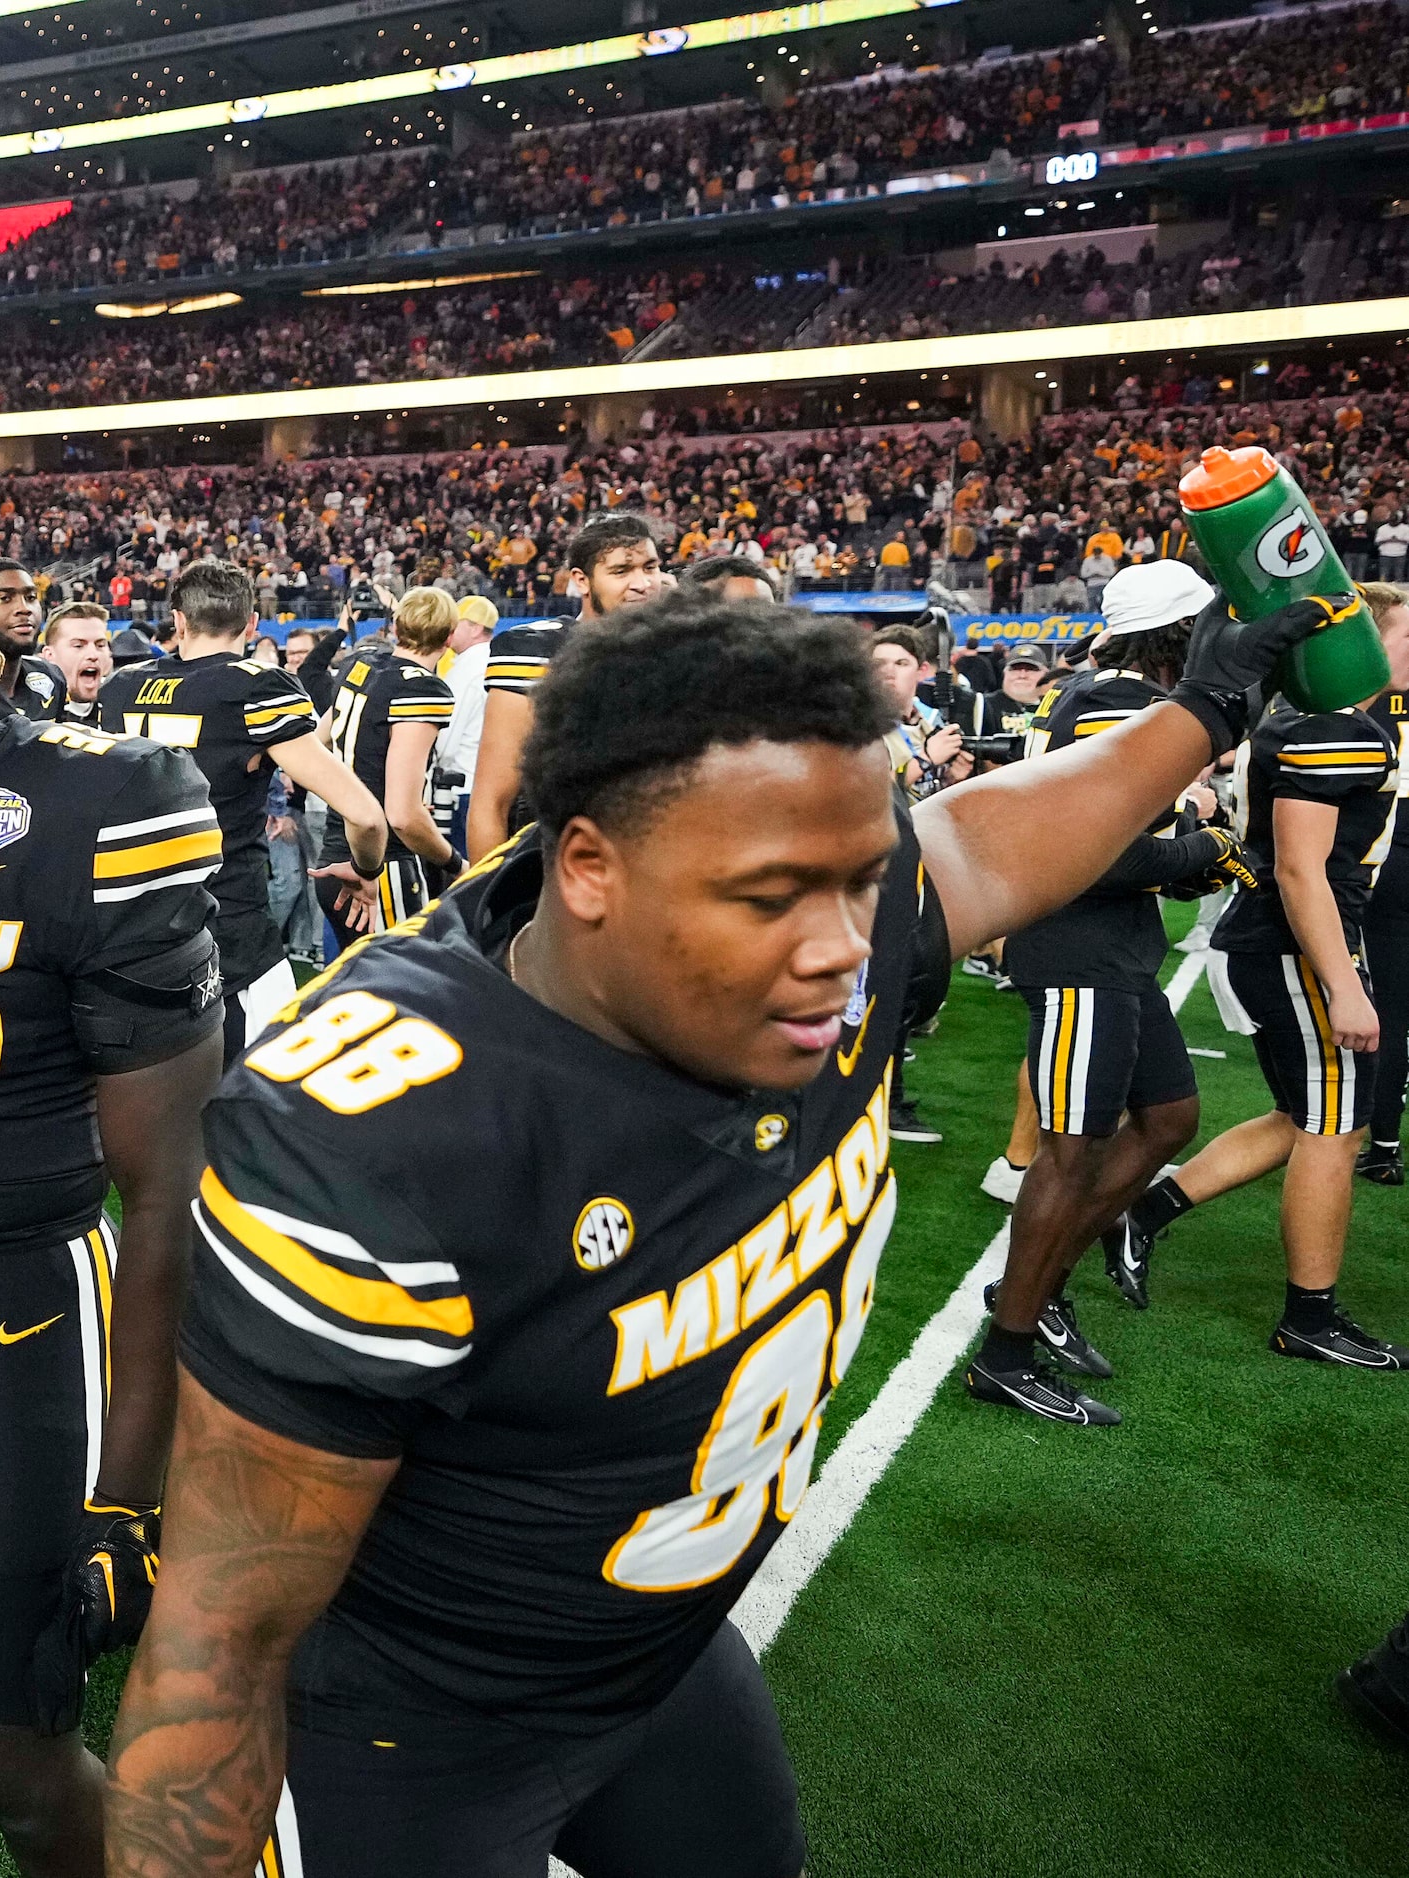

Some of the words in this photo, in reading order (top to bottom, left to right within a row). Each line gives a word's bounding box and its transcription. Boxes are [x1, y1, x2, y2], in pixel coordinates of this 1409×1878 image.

[1046, 152, 1097, 184] 0:00
[966, 615, 1106, 640] GOODYEA
[135, 677, 184, 705] LOCK
[243, 991, 464, 1114] 88
[577, 1202, 630, 1268] SEC
[606, 1054, 895, 1397] MIZZOU
